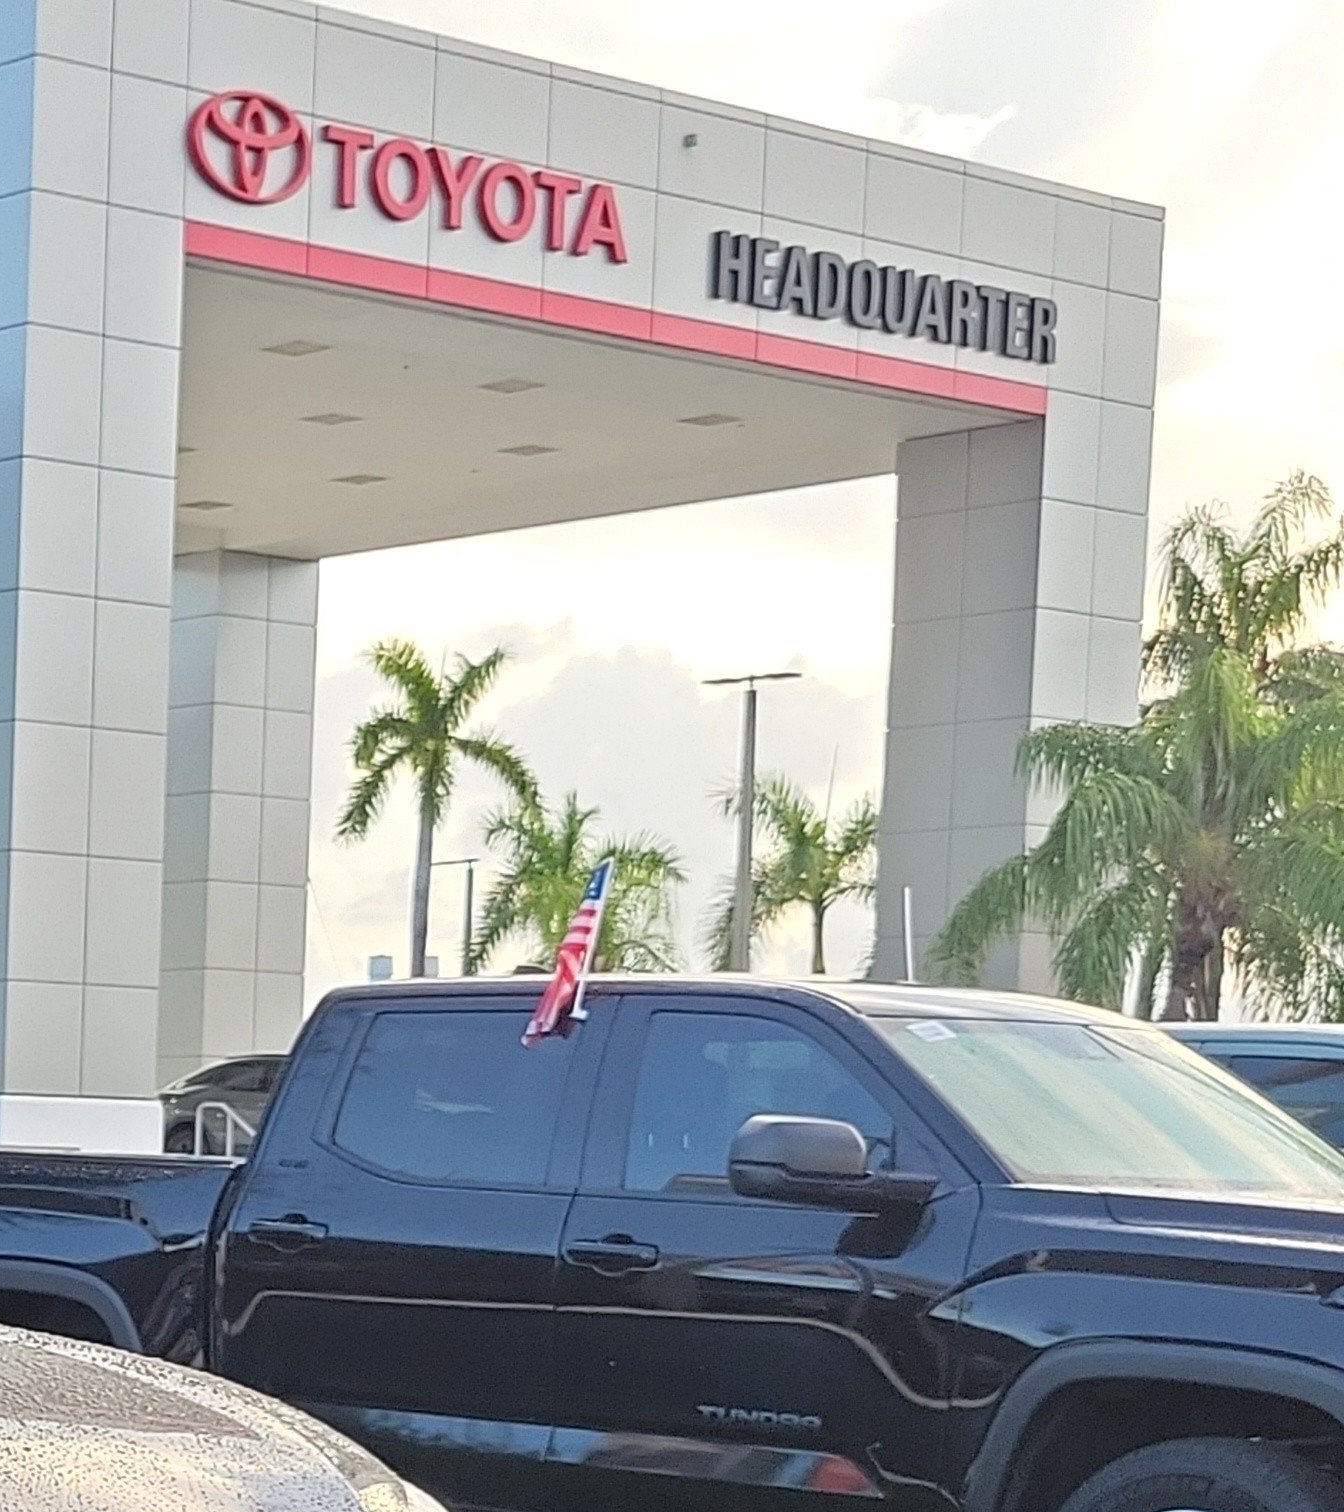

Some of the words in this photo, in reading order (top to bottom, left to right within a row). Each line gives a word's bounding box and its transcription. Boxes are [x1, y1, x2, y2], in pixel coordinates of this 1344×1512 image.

[324, 124, 628, 264] TOYOTA
[712, 229, 1058, 365] HEADQUARTER
[696, 1404, 822, 1428] TUNDRA
